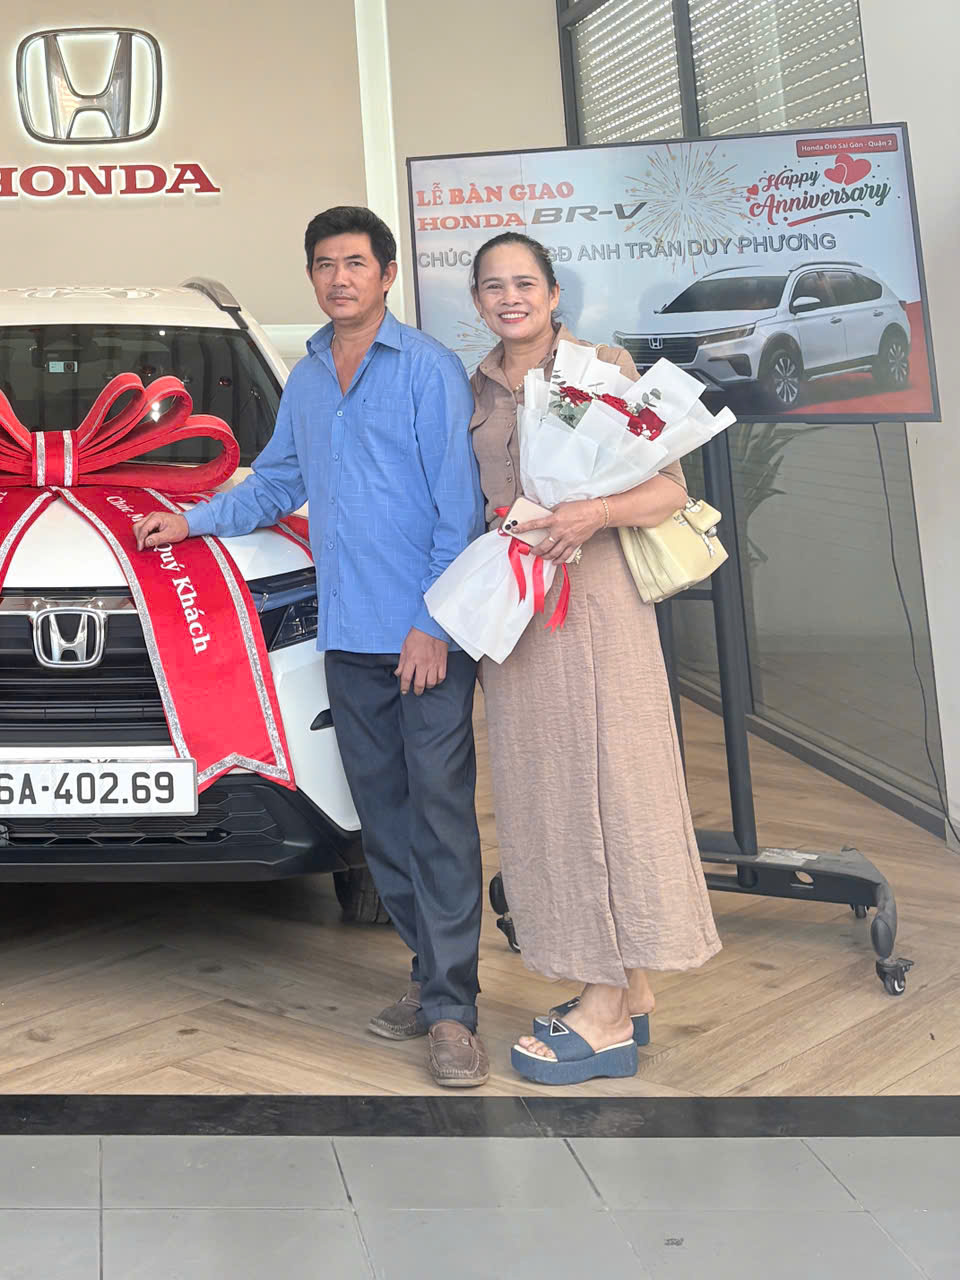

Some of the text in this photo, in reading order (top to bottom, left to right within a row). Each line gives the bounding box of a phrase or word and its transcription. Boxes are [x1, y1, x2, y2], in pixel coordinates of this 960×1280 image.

[801, 144, 823, 152] Honda
[416, 181, 574, 207] LỄ BÀN GIAO
[759, 169, 820, 192] Happy
[417, 202, 648, 231] HONDA BR-V
[749, 183, 892, 225] Anniversary
[417, 248, 472, 268] CHÚC
[577, 243, 621, 261] ANH
[687, 237, 733, 256] DUY
[738, 232, 837, 254] PHƯƠNG
[106, 496, 135, 513] Chúc
[172, 576, 211, 654] Khách
